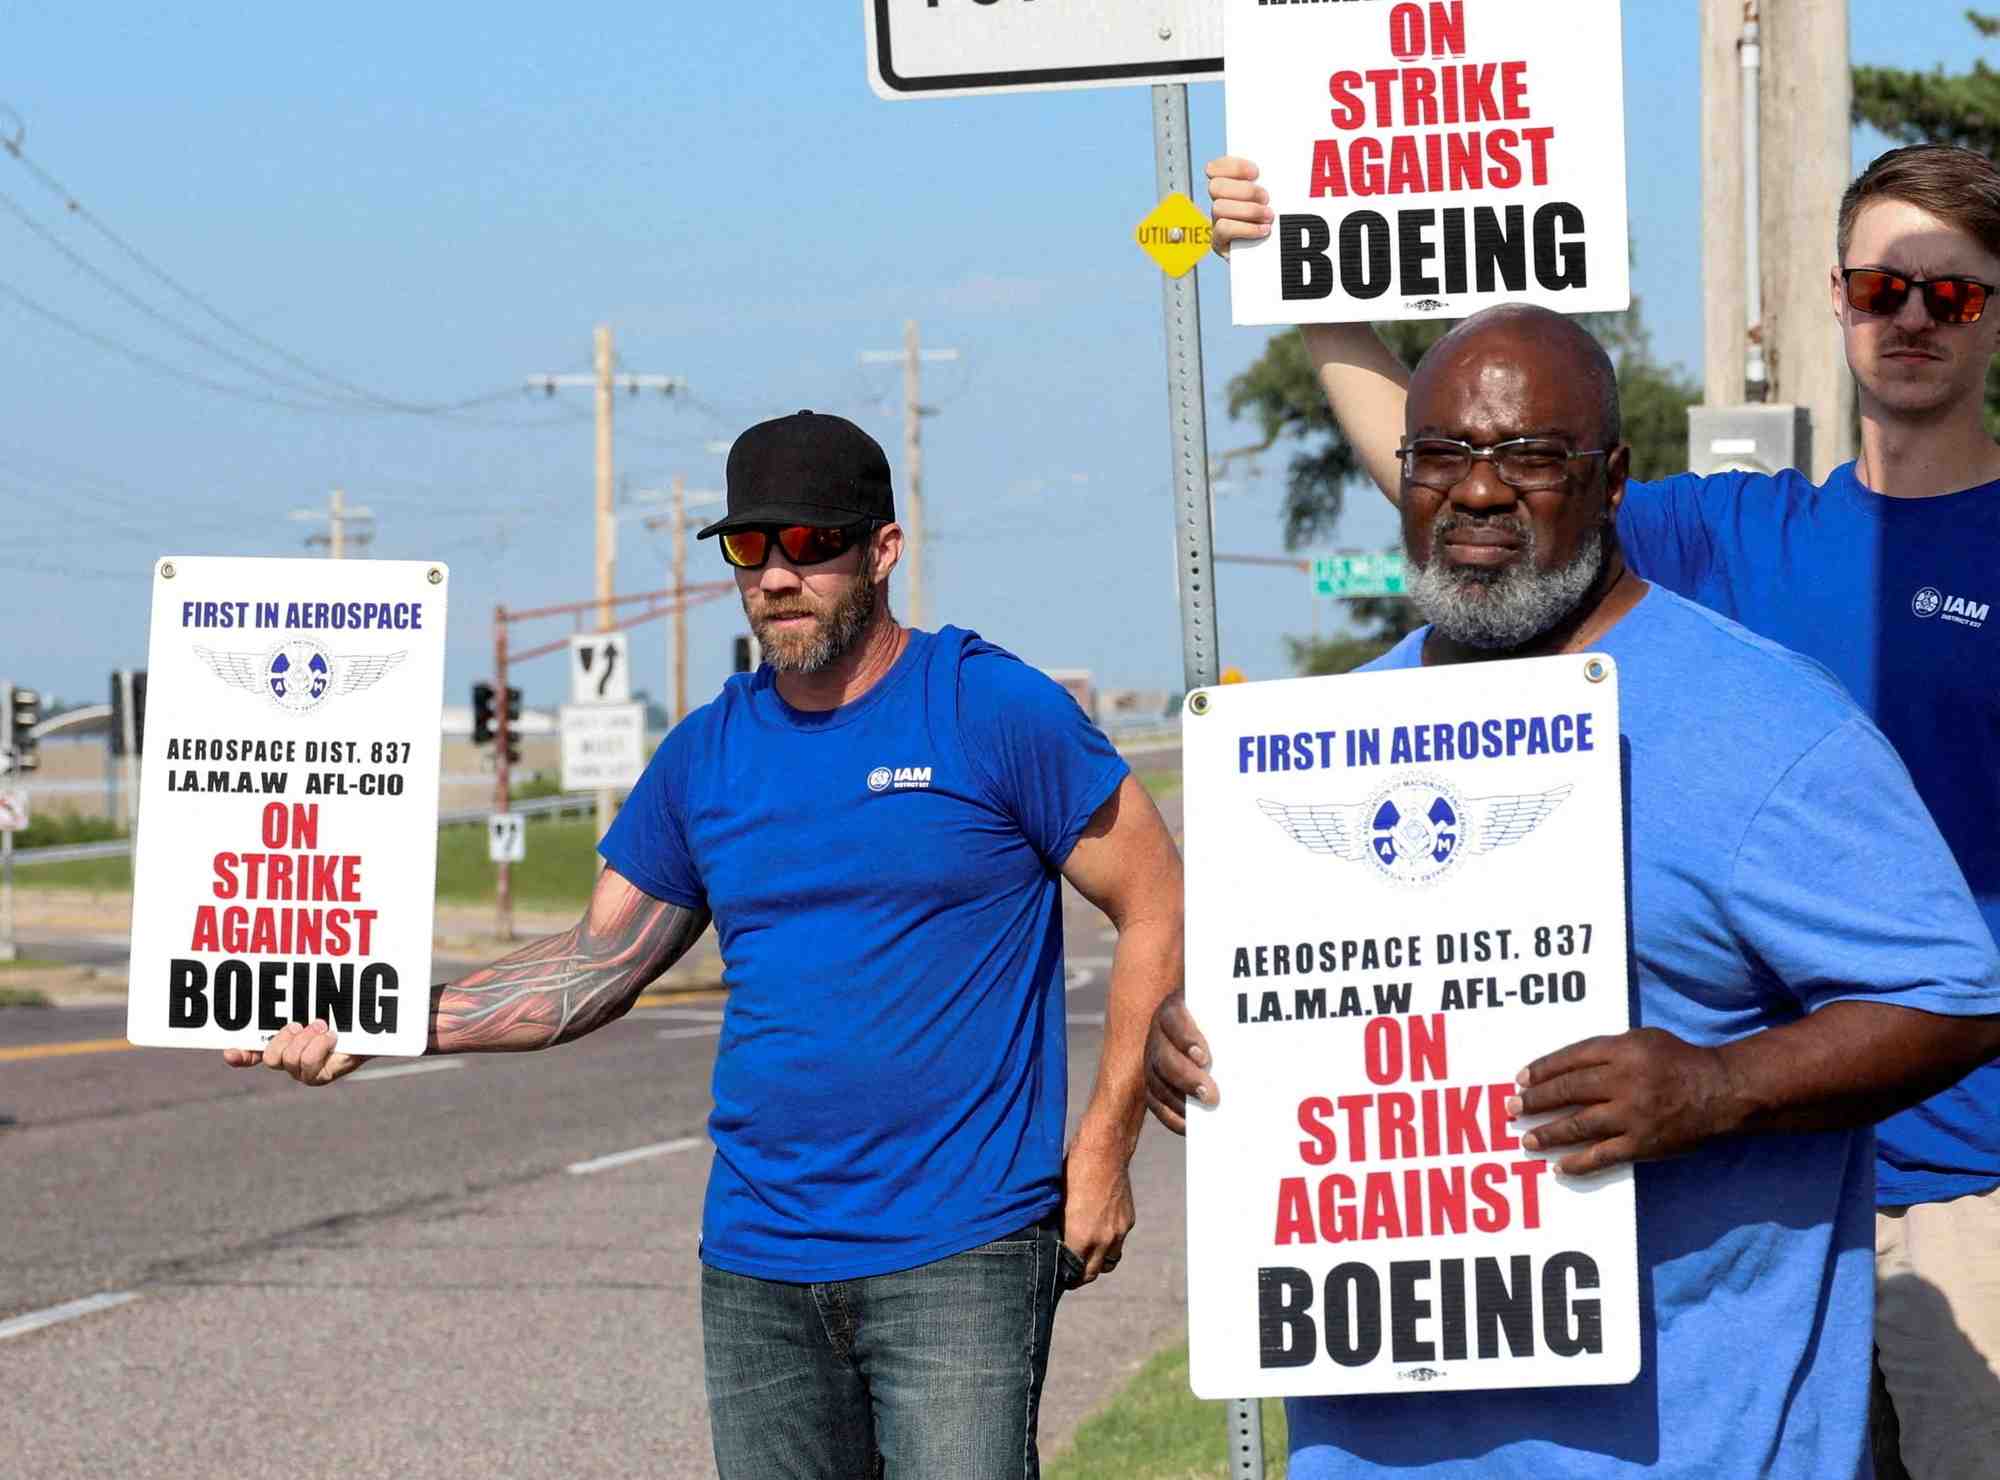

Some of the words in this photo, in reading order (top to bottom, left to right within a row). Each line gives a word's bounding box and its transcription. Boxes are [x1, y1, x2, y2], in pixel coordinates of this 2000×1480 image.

[1389, 0, 1466, 62] ON
[1328, 60, 1531, 131] STRIKE
[1309, 127, 1555, 199] AGAINST
[1138, 226, 1212, 245] UTILTIES
[1279, 201, 1588, 301] BOEING
[182, 601, 250, 628] FIRST
[255, 603, 280, 628] IN
[285, 603, 422, 630] AEROSPACE
[1943, 595, 1990, 621] IAM
[166, 738, 296, 763] AEROSPACE
[305, 741, 361, 764] DIST.
[370, 741, 411, 765] 837
[1238, 730, 1337, 774] FIRST
[1345, 727, 1381, 768] IN
[1390, 712, 1595, 764] AEROSPACE
[168, 769, 288, 794] I.A.M.A.W
[305, 772, 404, 796] AFL-CIO
[893, 767, 932, 781] IAM
[262, 801, 320, 850] ON
[212, 851, 362, 903] STRIKE
[191, 904, 378, 957] AGAINST
[1232, 935, 1422, 979] AEROSPACE
[1436, 926, 1520, 965] DIST.
[1534, 923, 1593, 958] 837
[168, 958, 400, 1035] BOEING
[1237, 982, 1414, 1024] I.A.M.A.W
[1440, 970, 1586, 1011] AFL-CIO
[1363, 1012, 1449, 1087] ON
[1297, 1082, 1522, 1167] STRIKE
[1274, 1159, 1549, 1246] AGAINST
[1257, 1250, 1604, 1369] BOEING
